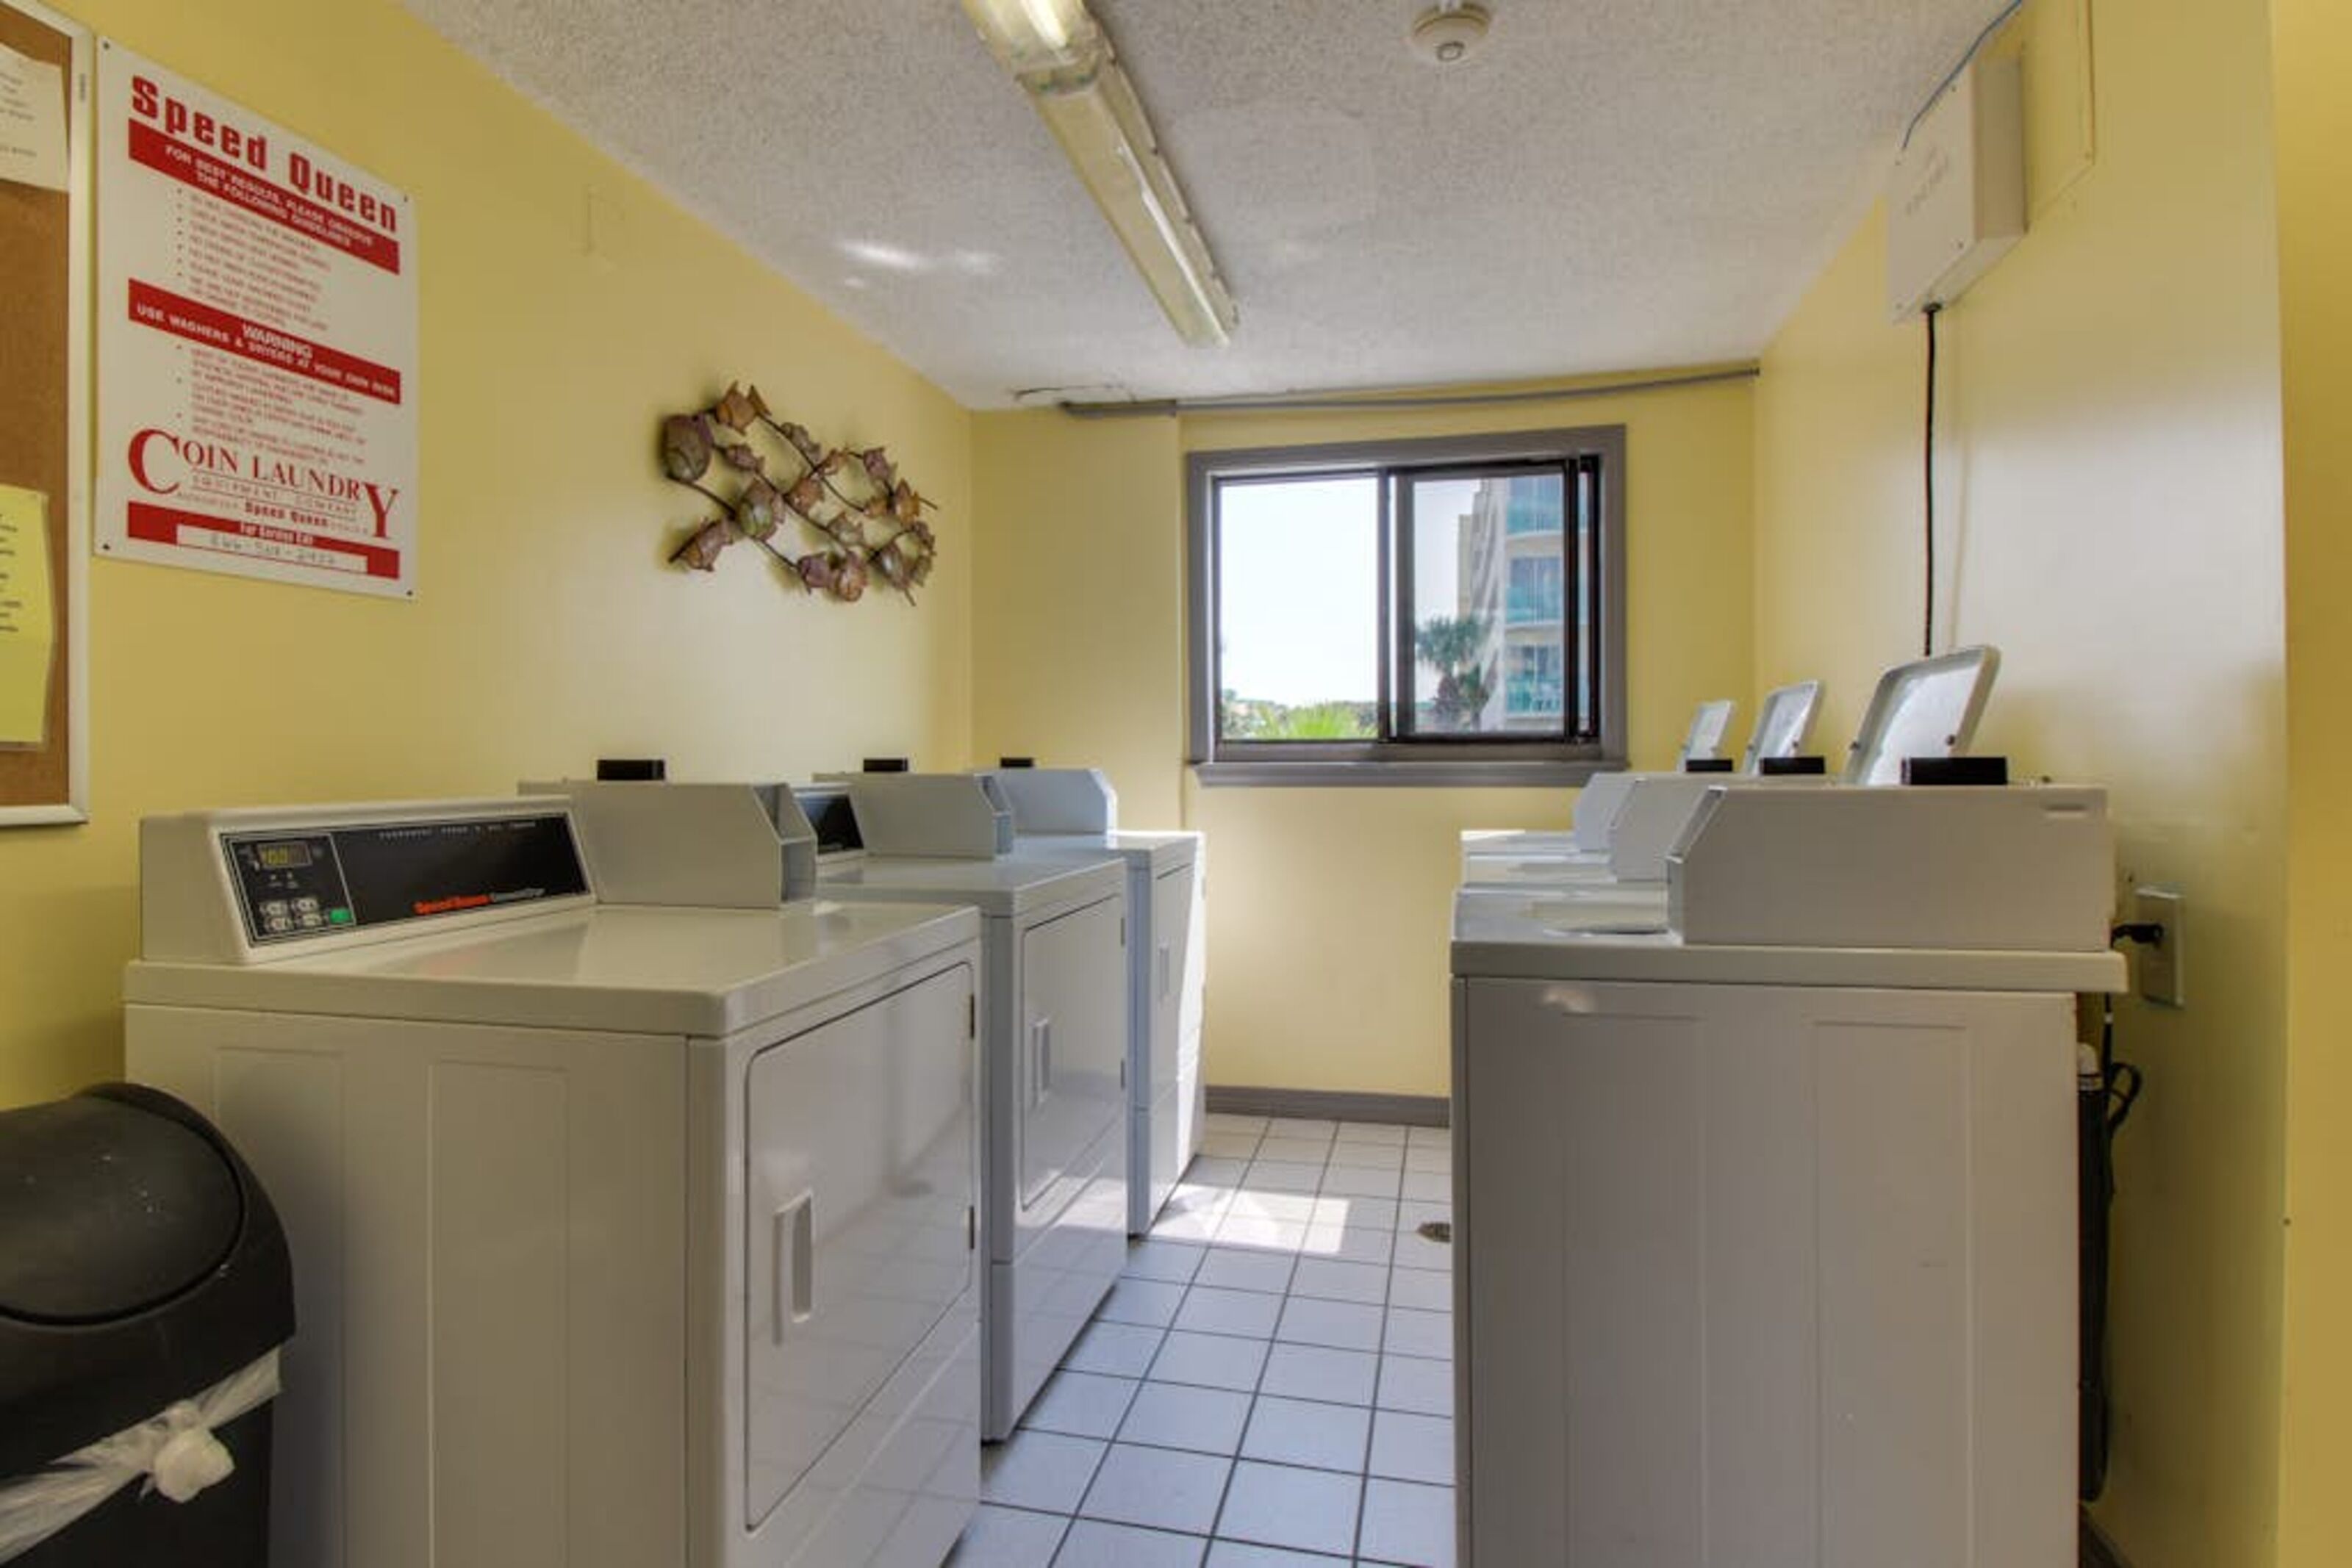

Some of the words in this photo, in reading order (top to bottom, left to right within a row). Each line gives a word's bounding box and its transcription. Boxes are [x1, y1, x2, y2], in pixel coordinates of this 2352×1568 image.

[132, 75, 267, 170] Speed
[288, 151, 397, 233] Queen
[165, 144, 192, 165] FOR
[195, 158, 226, 180] BEST
[136, 300, 165, 323] USE
[168, 312, 231, 344] WASHERS
[242, 321, 314, 359] WARNING
